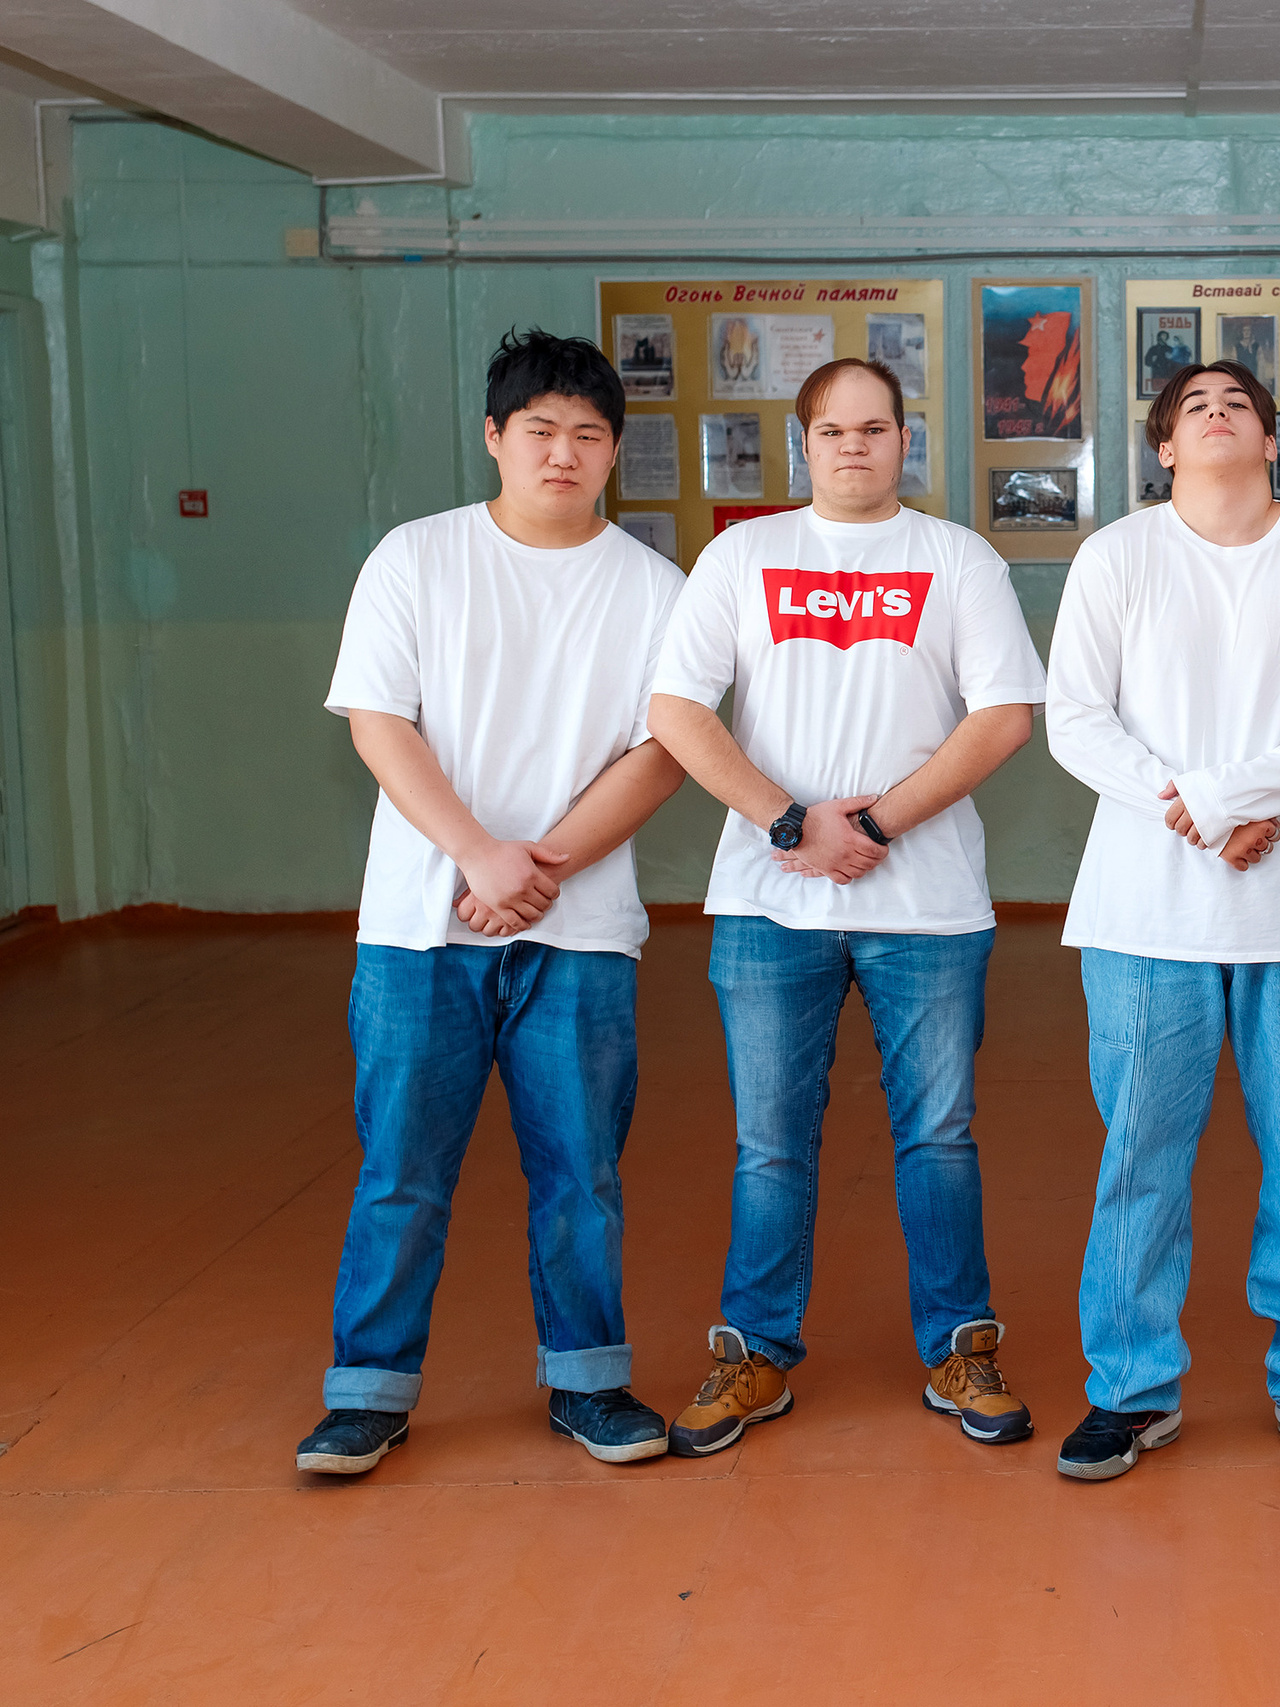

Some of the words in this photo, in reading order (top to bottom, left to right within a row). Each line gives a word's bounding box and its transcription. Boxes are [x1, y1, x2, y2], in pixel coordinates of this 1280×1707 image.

[665, 286, 723, 303] Огонь
[733, 283, 806, 302] Вечной
[816, 287, 899, 302] памяти
[1192, 284, 1263, 298] Вставай
[1158, 316, 1193, 330] БУДЬ
